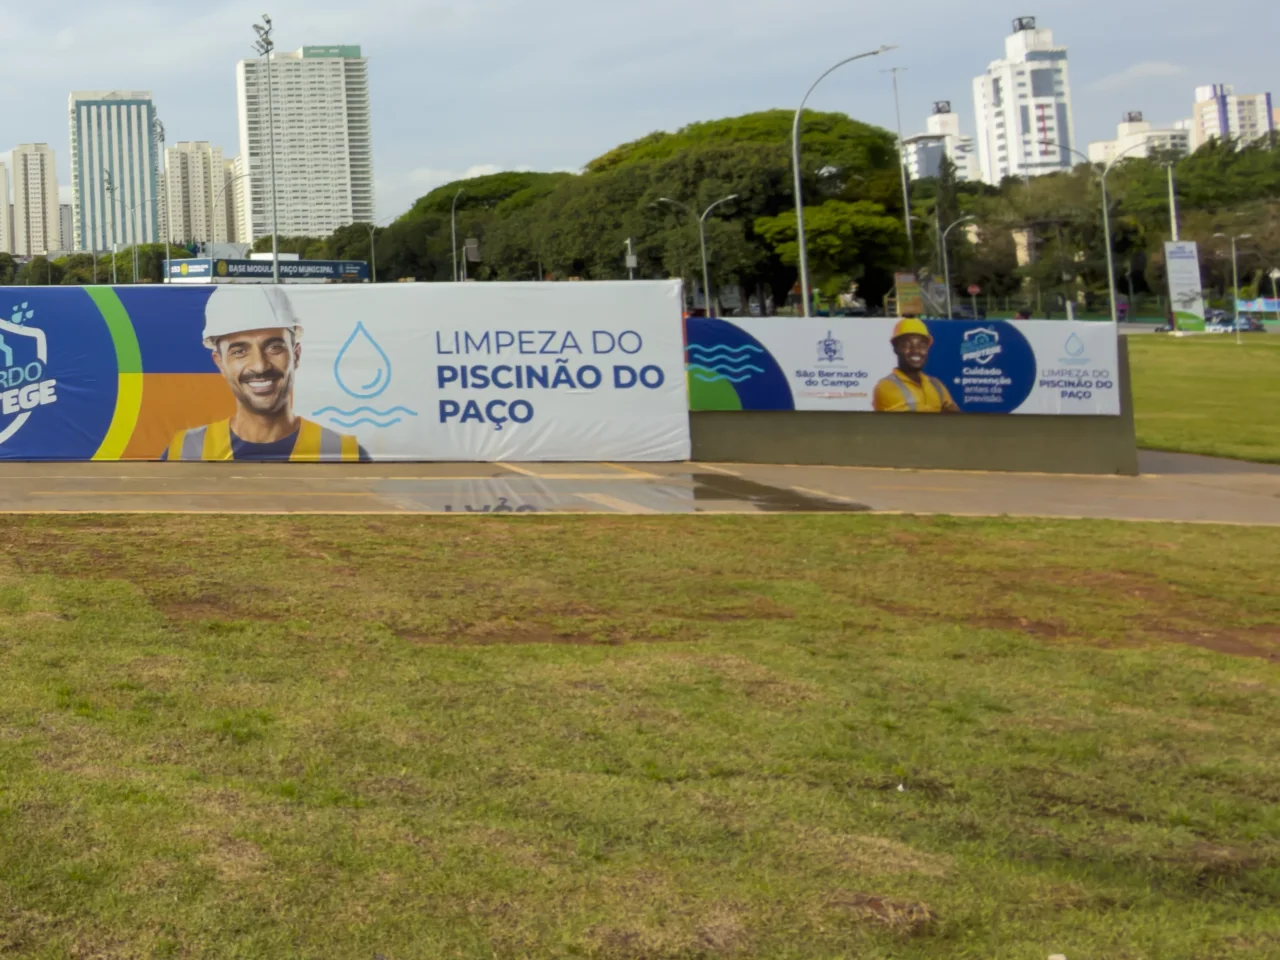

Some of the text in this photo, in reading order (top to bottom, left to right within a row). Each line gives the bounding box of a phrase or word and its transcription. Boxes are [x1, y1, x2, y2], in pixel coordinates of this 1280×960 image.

[228, 265, 334, 275] BASE MODULA PAÇO MUNICIPAL
[436, 330, 643, 355] LIMPEZA DO
[438, 358, 665, 390] PISCINÃO DO
[795, 369, 869, 378] São Bernardo
[962, 367, 1002, 375] Cuidado
[1041, 369, 1109, 378] LIMPEZA DO
[805, 378, 860, 388] do Campo
[962, 376, 1012, 386] prevenção
[1039, 378, 1113, 388] PISCINÃO DO
[1060, 390, 1092, 400] PAÇO
[439, 399, 534, 431] PAÇO
